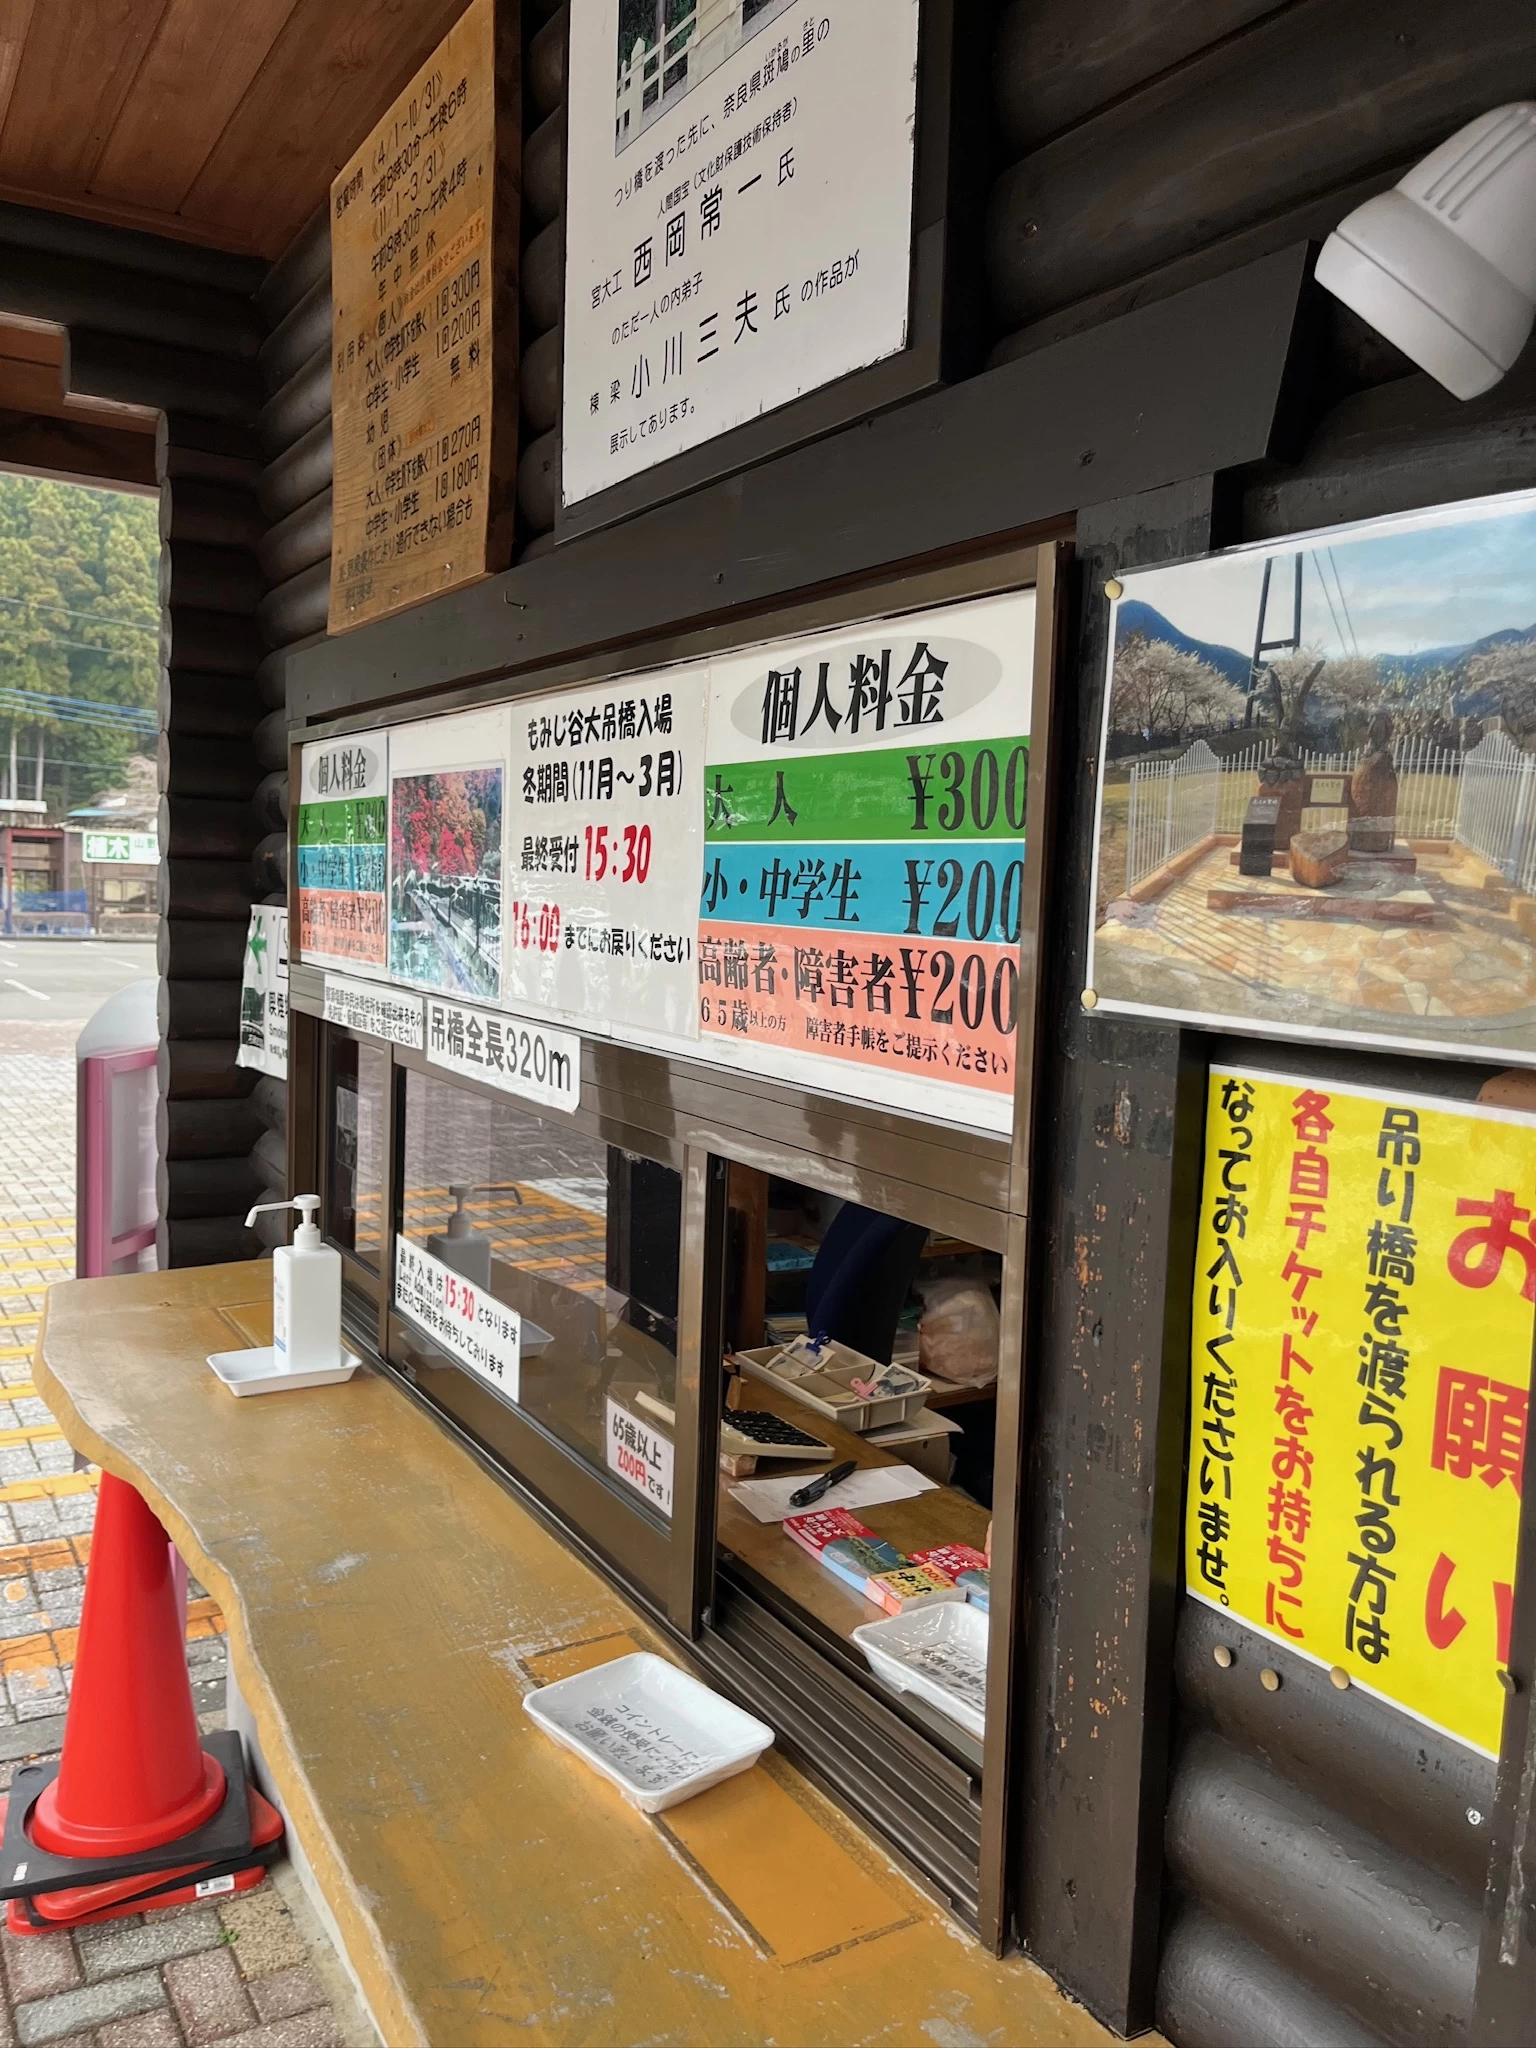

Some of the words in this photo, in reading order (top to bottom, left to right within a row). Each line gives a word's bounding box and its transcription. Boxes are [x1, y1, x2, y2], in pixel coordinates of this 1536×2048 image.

[436, 259, 480, 320] 1回300円
[591, 269, 622, 309] 宮大工
[611, 271, 703, 345] のただ一人の内弟子
[436, 300, 480, 358] 1回200円
[436, 415, 480, 467] 1回270円
[610, 397, 695, 455] 展示してあります。
[435, 453, 479, 502] 1回180円
[528, 693, 673, 751] もみじ谷大吊橋入場
[761, 642, 949, 745] 個人料金
[318, 748, 367, 794] 個人料金
[706, 770, 797, 831] 大人
[905, 744, 1029, 832] ¥300
[521, 835, 579, 874] 最終受付
[585, 824, 652, 884] 15:30
[702, 856, 862, 923] 小・中学生
[902, 858, 1025, 945] ¥200
[564, 923, 691, 963] までにお戻りください
[431, 1004, 571, 1092] 吊橋全長320m
[445, 1275, 475, 1322] 15:30
[1196, 1077, 1254, 1608] なってお入りくださいませ。
[1265, 1089, 1335, 1639] 各自チケットをお持ちに
[1345, 1106, 1421, 1665] 吊り橋を渡られる方は
[613, 1413, 662, 1472] 65歳以上
